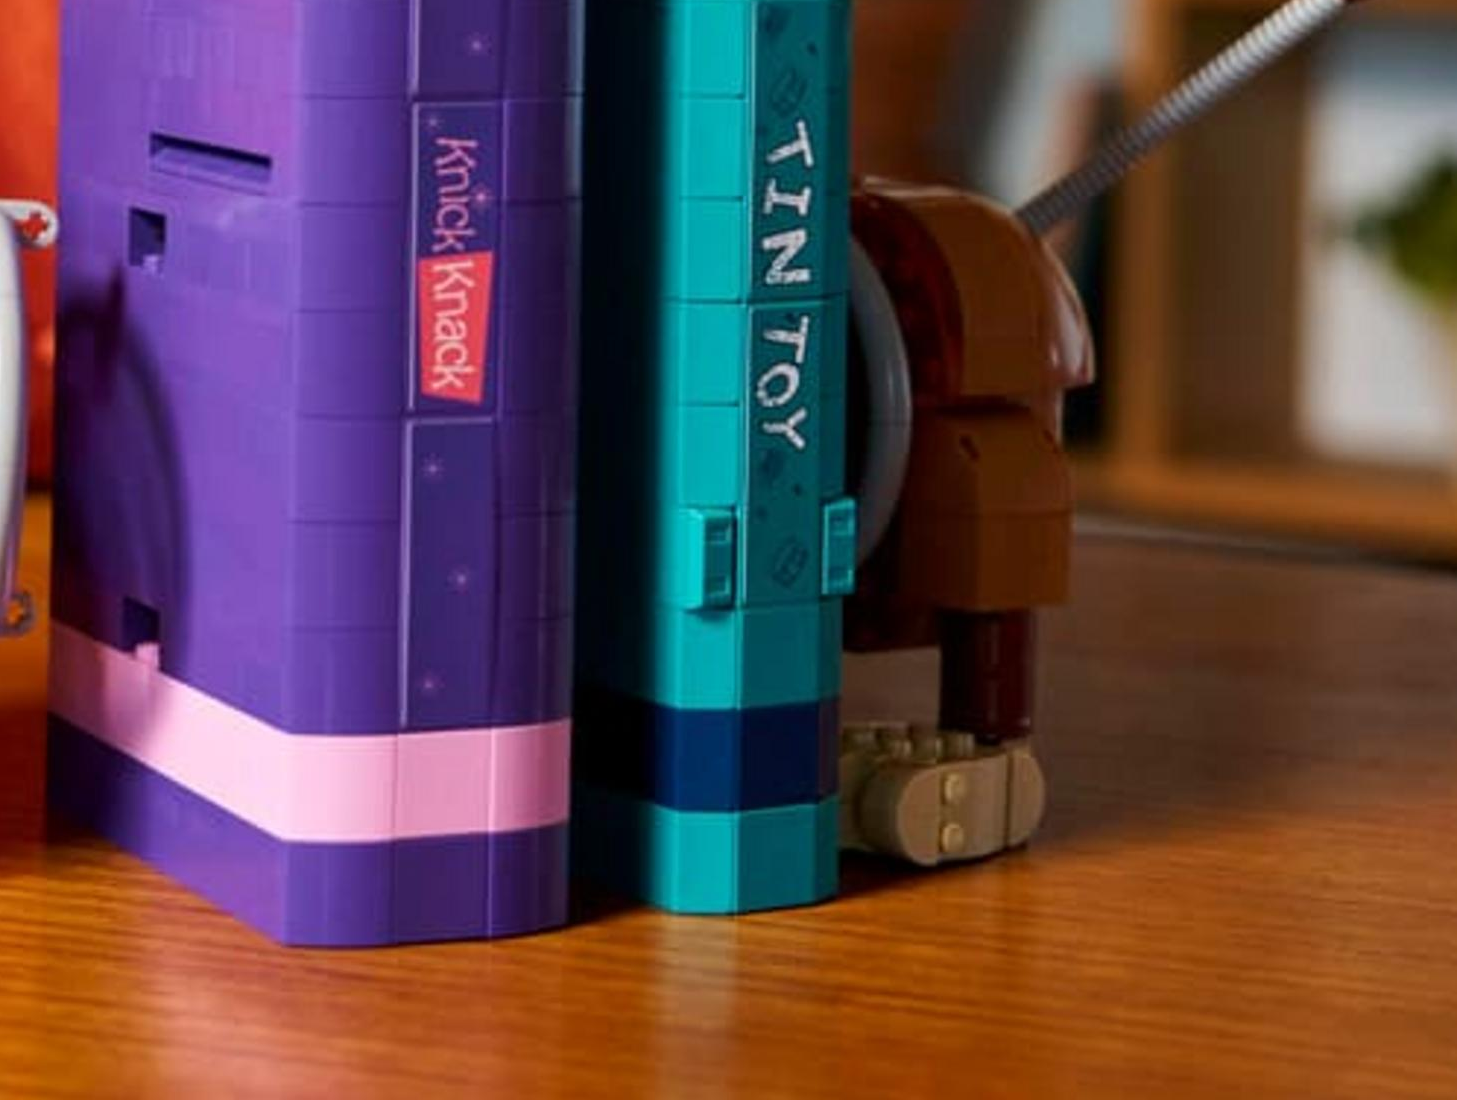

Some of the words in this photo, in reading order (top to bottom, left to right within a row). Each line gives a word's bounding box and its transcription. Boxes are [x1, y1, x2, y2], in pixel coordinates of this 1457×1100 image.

[431, 135, 481, 253] Knick
[760, 118, 815, 286] TIN
[430, 259, 476, 391] Knack
[755, 315, 810, 451] TOY
